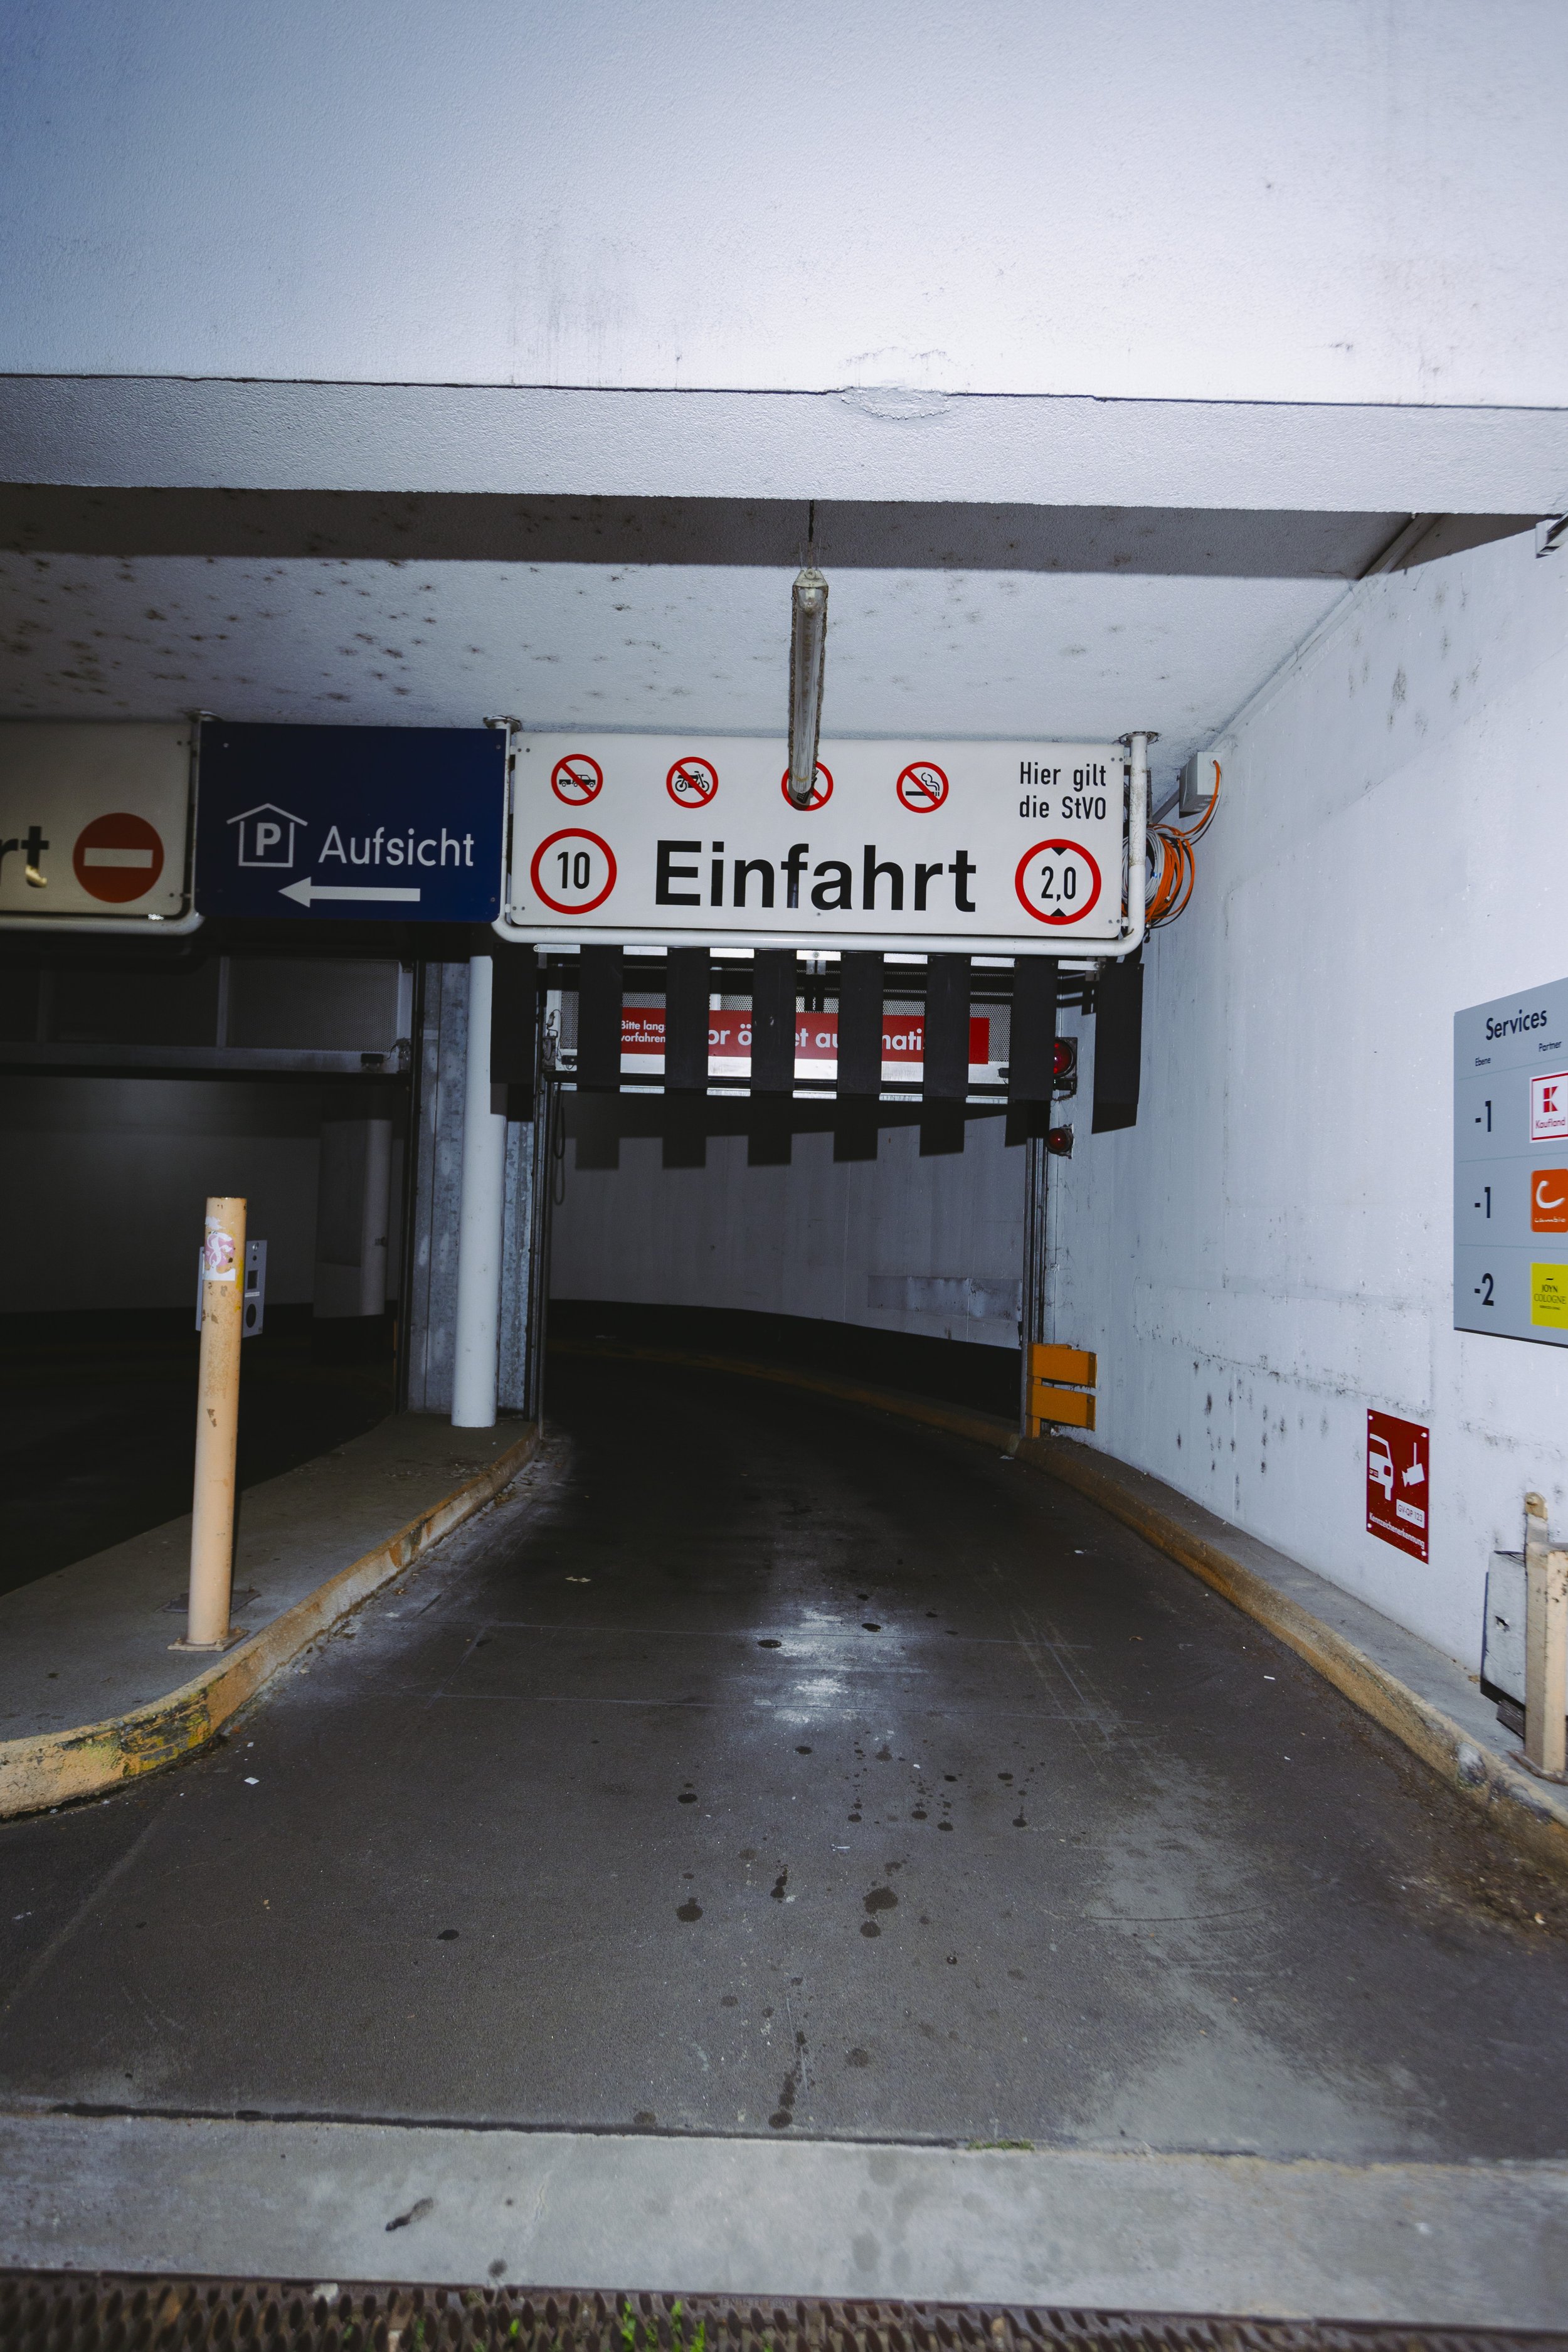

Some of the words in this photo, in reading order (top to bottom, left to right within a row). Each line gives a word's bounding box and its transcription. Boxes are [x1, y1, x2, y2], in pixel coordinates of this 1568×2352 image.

[1019, 761, 1062, 786] Hier
[1073, 763, 1107, 793] gilt
[1019, 793, 1050, 818] die
[1061, 796, 1106, 820] StVO
[318, 825, 475, 867] Aufsicht
[557, 851, 591, 890] 10
[655, 840, 977, 912] Einfahrt
[1041, 866, 1076, 903] 2,0
[622, 1020, 640, 1030] Bitte
[644, 1020, 666, 1034] lang
[708, 1029, 731, 1045] or
[1485, 1009, 1547, 1041] Services
[1475, 1057, 1491, 1066] Ebene
[1539, 1041, 1562, 1052] Partner
[1475, 1100, 1491, 1132] -1
[1535, 1117, 1565, 1128] Kaufland
[1475, 1187, 1491, 1219] -1
[1474, 1273, 1495, 1306] -2
[1534, 1293, 1566, 1305] COLOGNE
